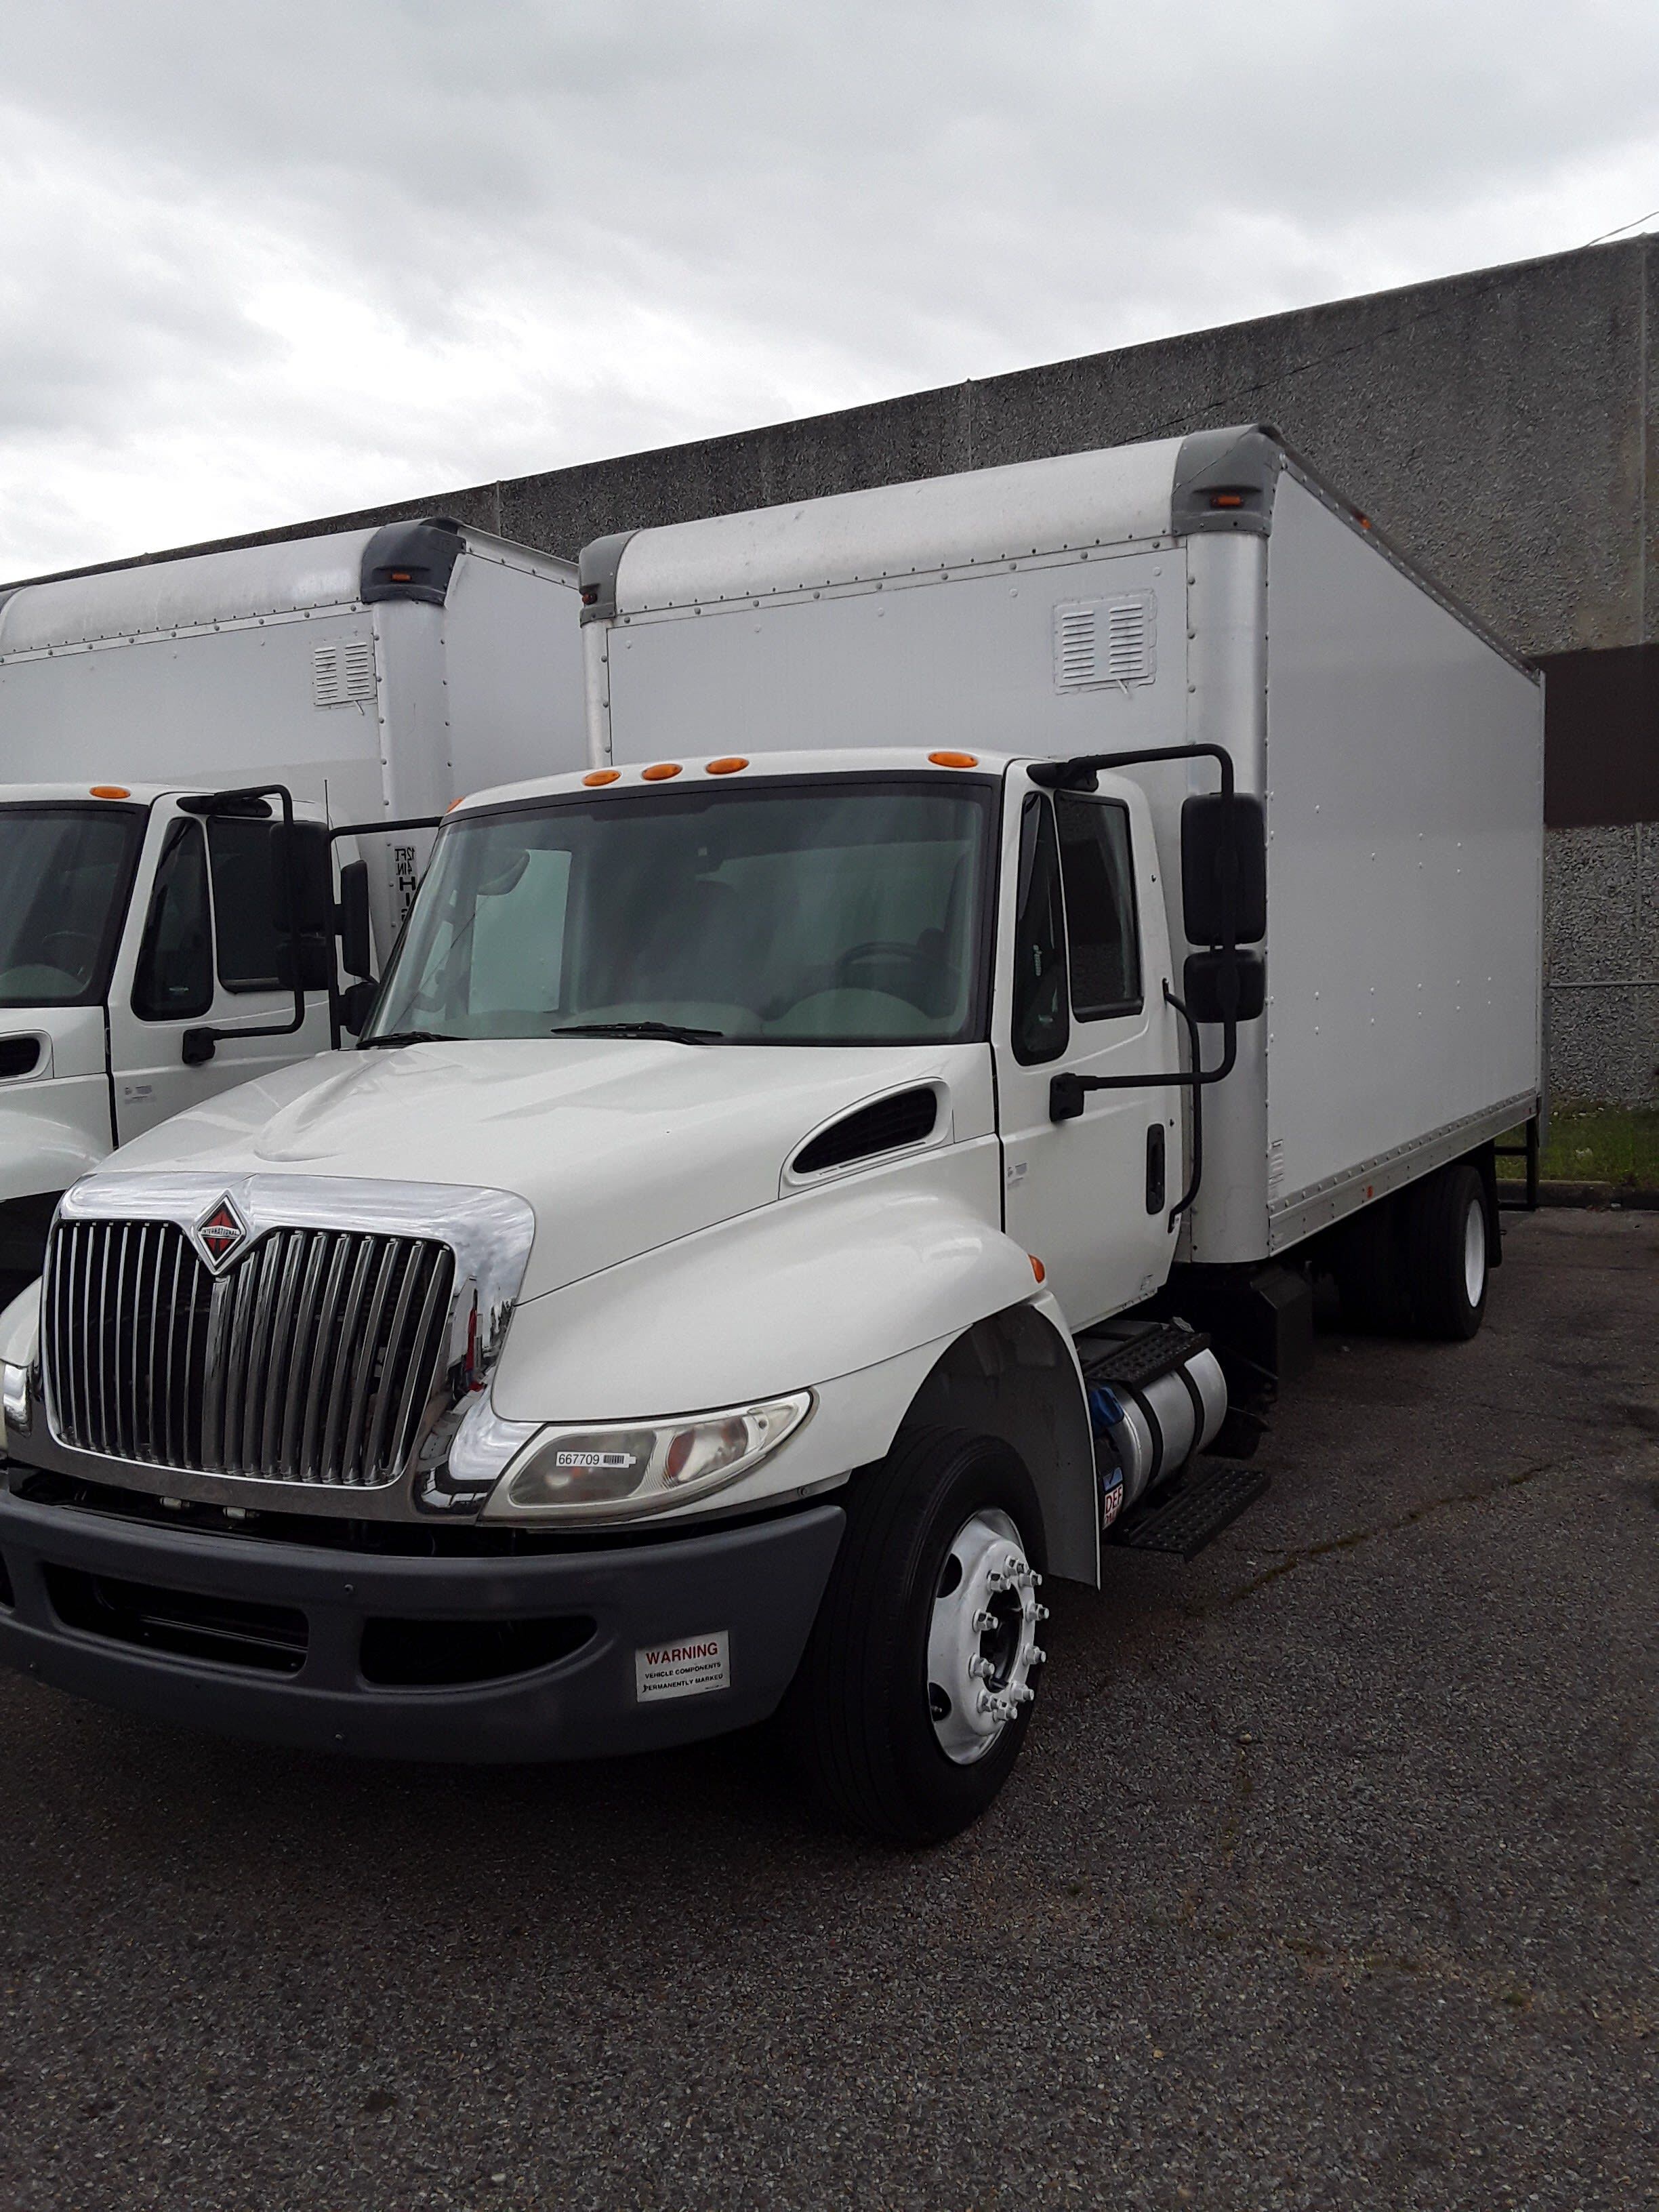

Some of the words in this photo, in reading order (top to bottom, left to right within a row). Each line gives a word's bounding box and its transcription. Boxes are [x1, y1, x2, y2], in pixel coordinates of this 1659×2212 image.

[558, 1454, 600, 1465] 667709
[1105, 1486, 1122, 1515] DEF
[646, 1642, 718, 1664] WARNING
[645, 1670, 673, 1679] VEHICLE
[675, 1662, 721, 1675] COMPONENTS
[643, 1679, 693, 1692] PERMANENTLY
[695, 1673, 723, 1683] MARKED
